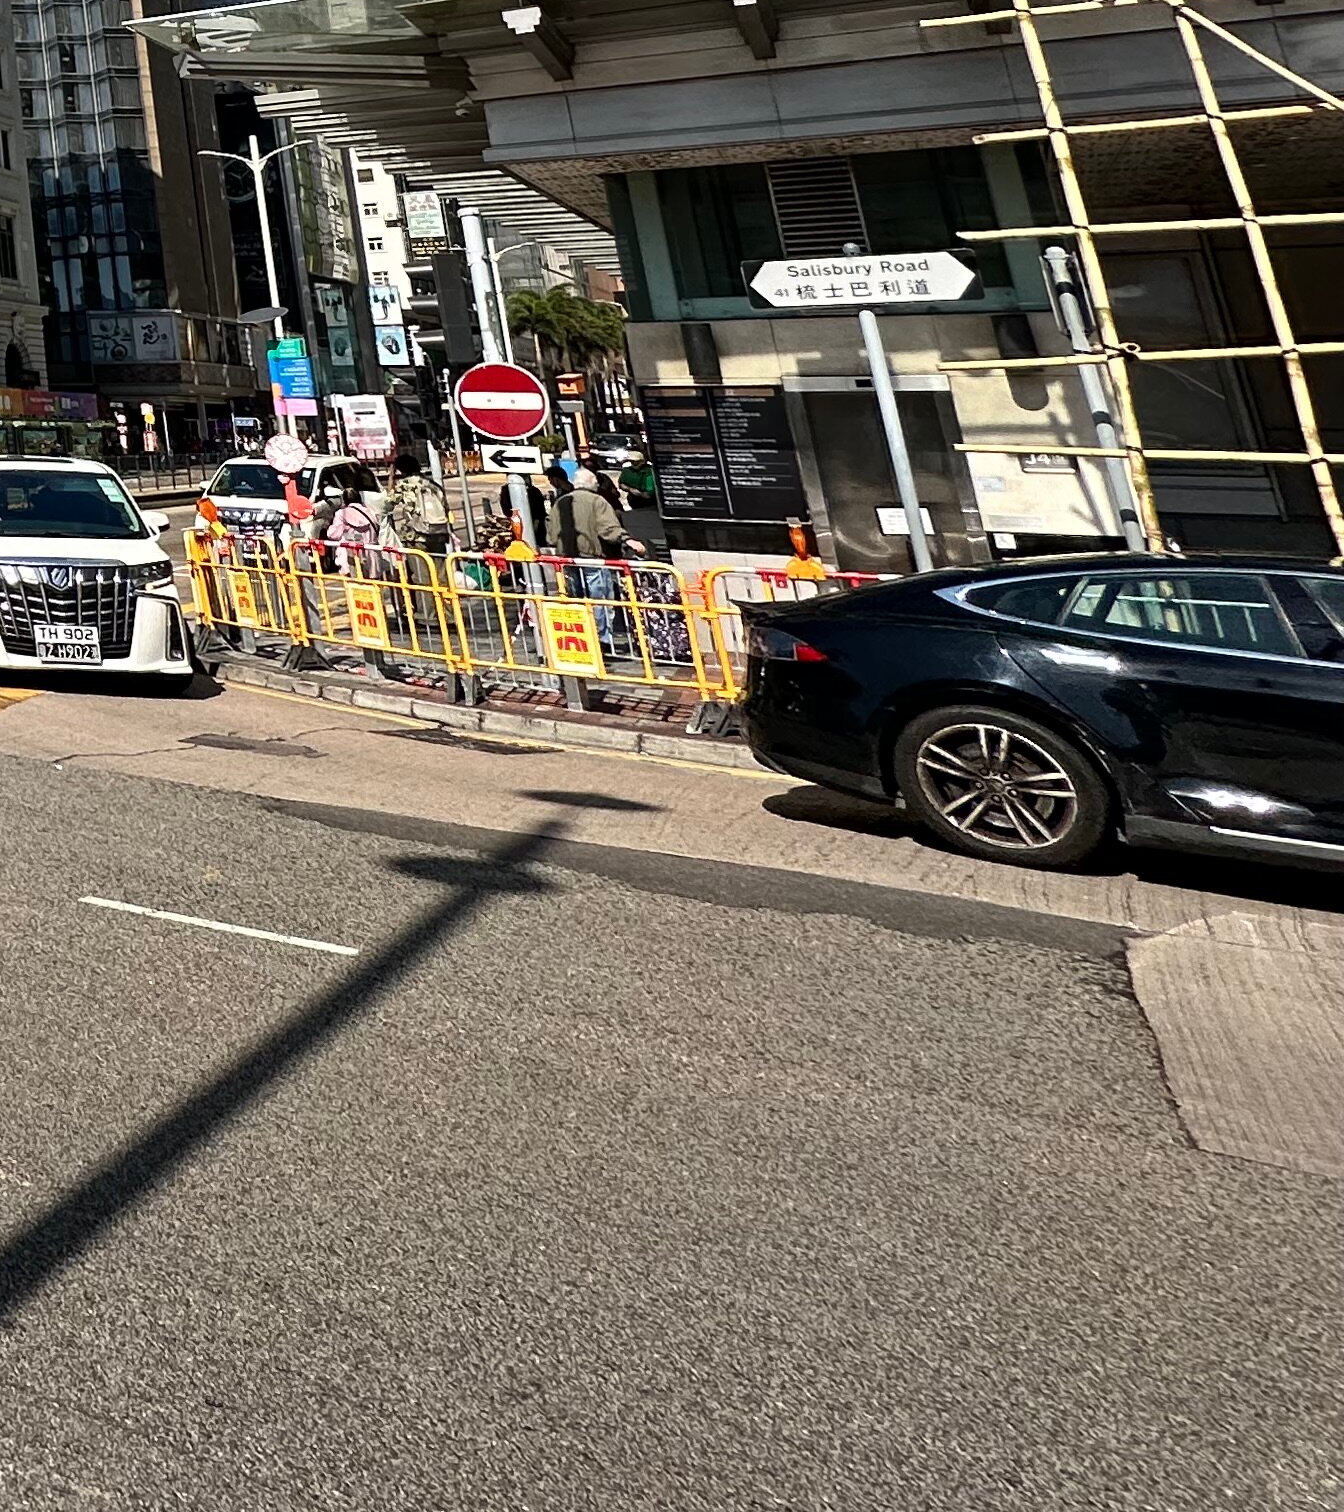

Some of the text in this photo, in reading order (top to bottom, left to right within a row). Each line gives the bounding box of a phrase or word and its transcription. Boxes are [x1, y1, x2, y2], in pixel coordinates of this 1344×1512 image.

[787, 259, 930, 279] Salisbury Road
[774, 278, 932, 300] 41 梳士巴利道
[38, 627, 93, 640] TH 902
